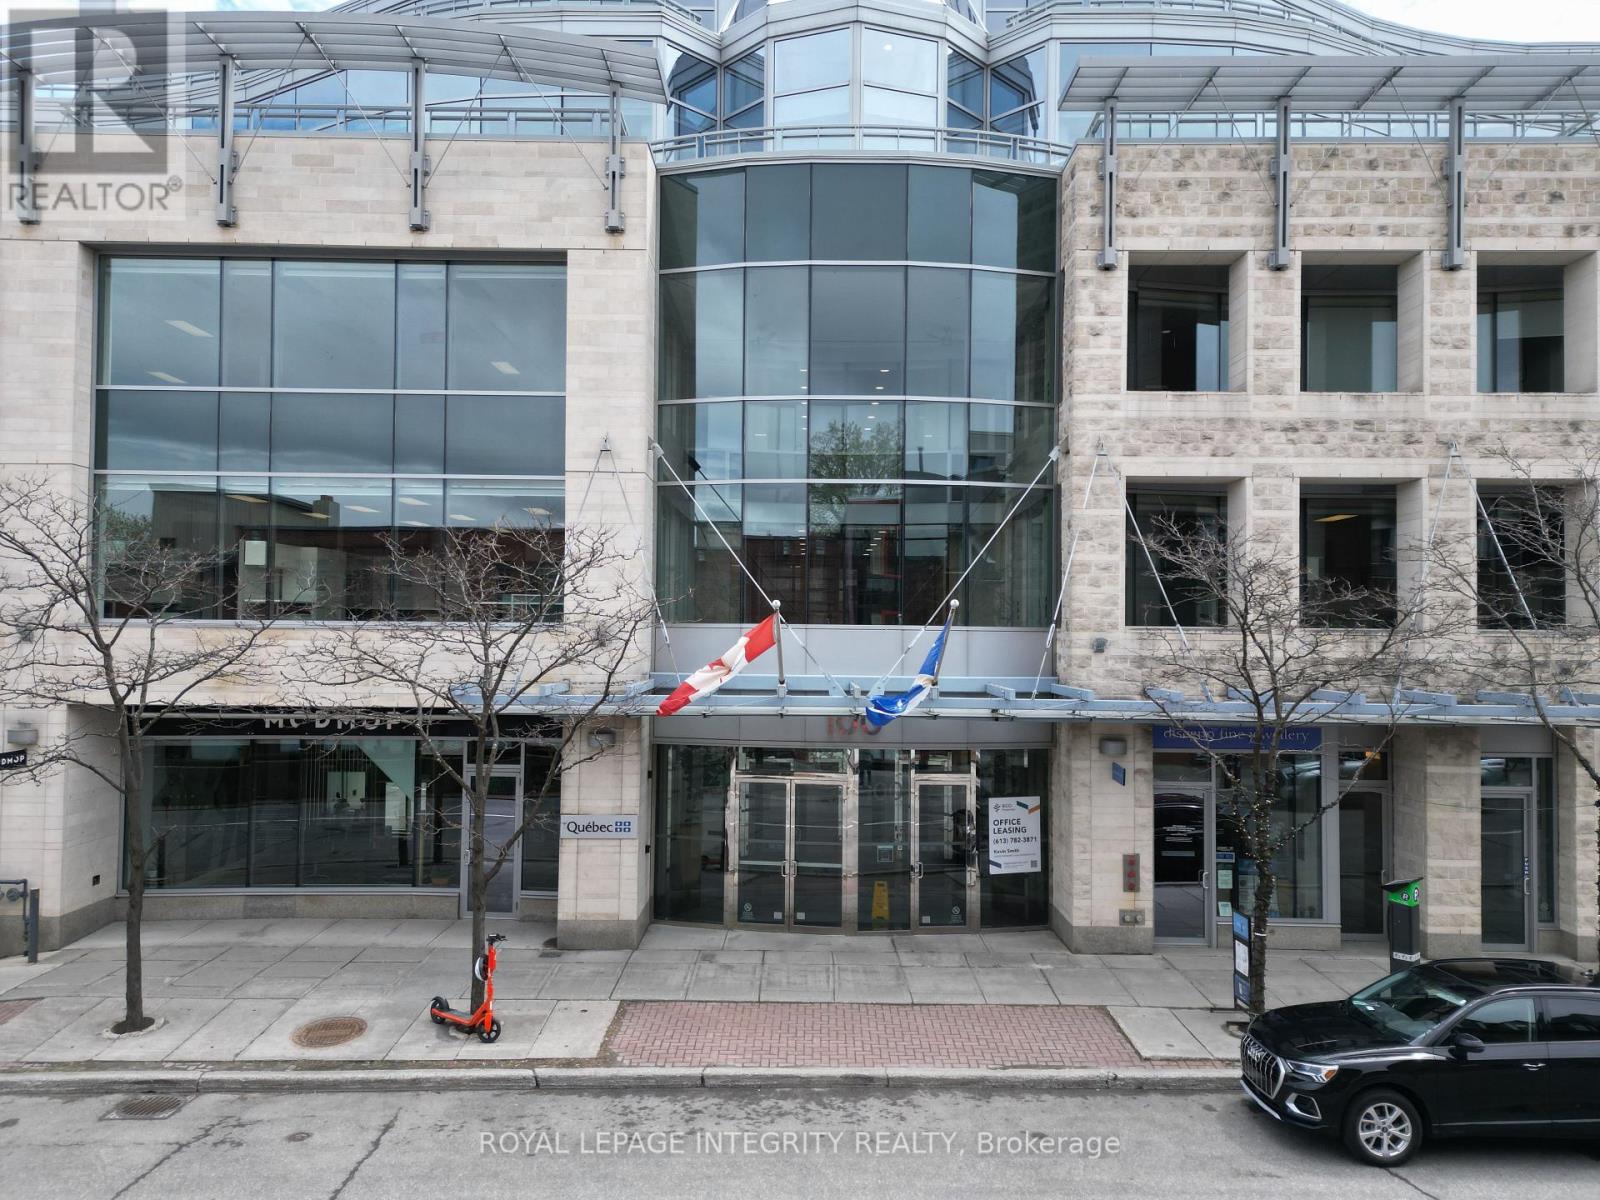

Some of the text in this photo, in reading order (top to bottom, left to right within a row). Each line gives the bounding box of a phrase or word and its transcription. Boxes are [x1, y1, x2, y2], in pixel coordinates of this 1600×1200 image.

[993, 818, 1021, 826] OFFICE
[566, 821, 614, 834] Québec
[992, 837, 1009, 845] (613)
